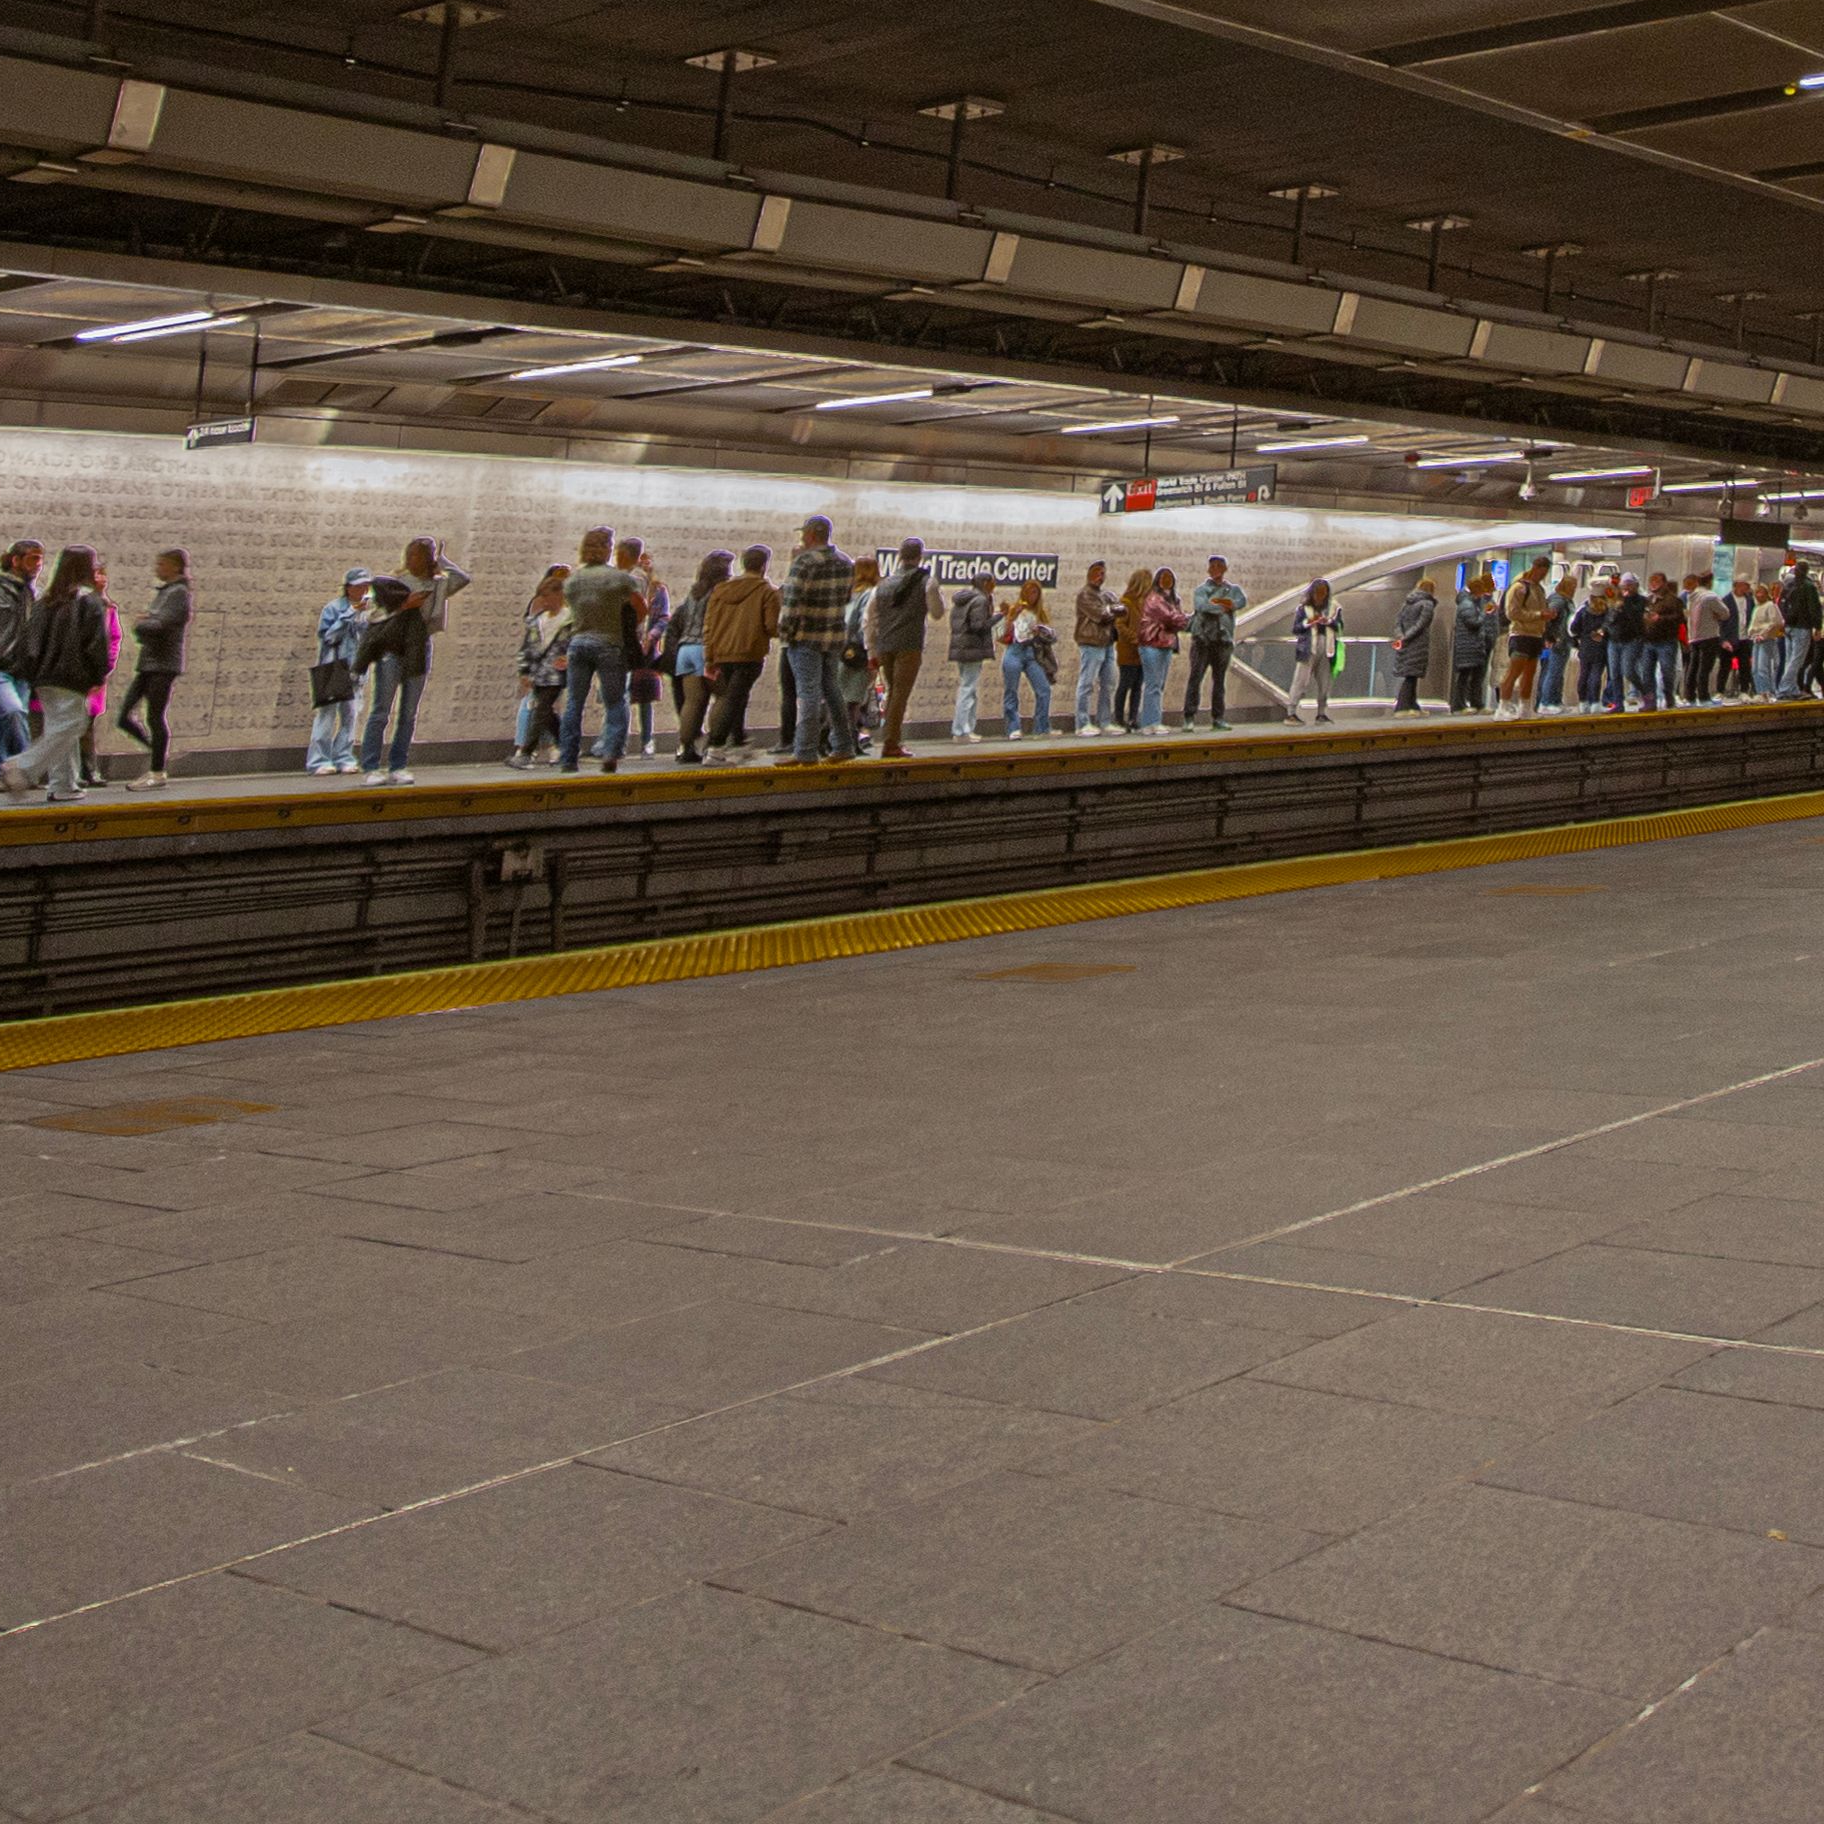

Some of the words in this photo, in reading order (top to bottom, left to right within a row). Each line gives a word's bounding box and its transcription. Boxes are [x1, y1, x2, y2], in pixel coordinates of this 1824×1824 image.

[1126, 483, 1153, 496] Exit
[939, 554, 992, 581] Trade
[993, 556, 1057, 582] Center
